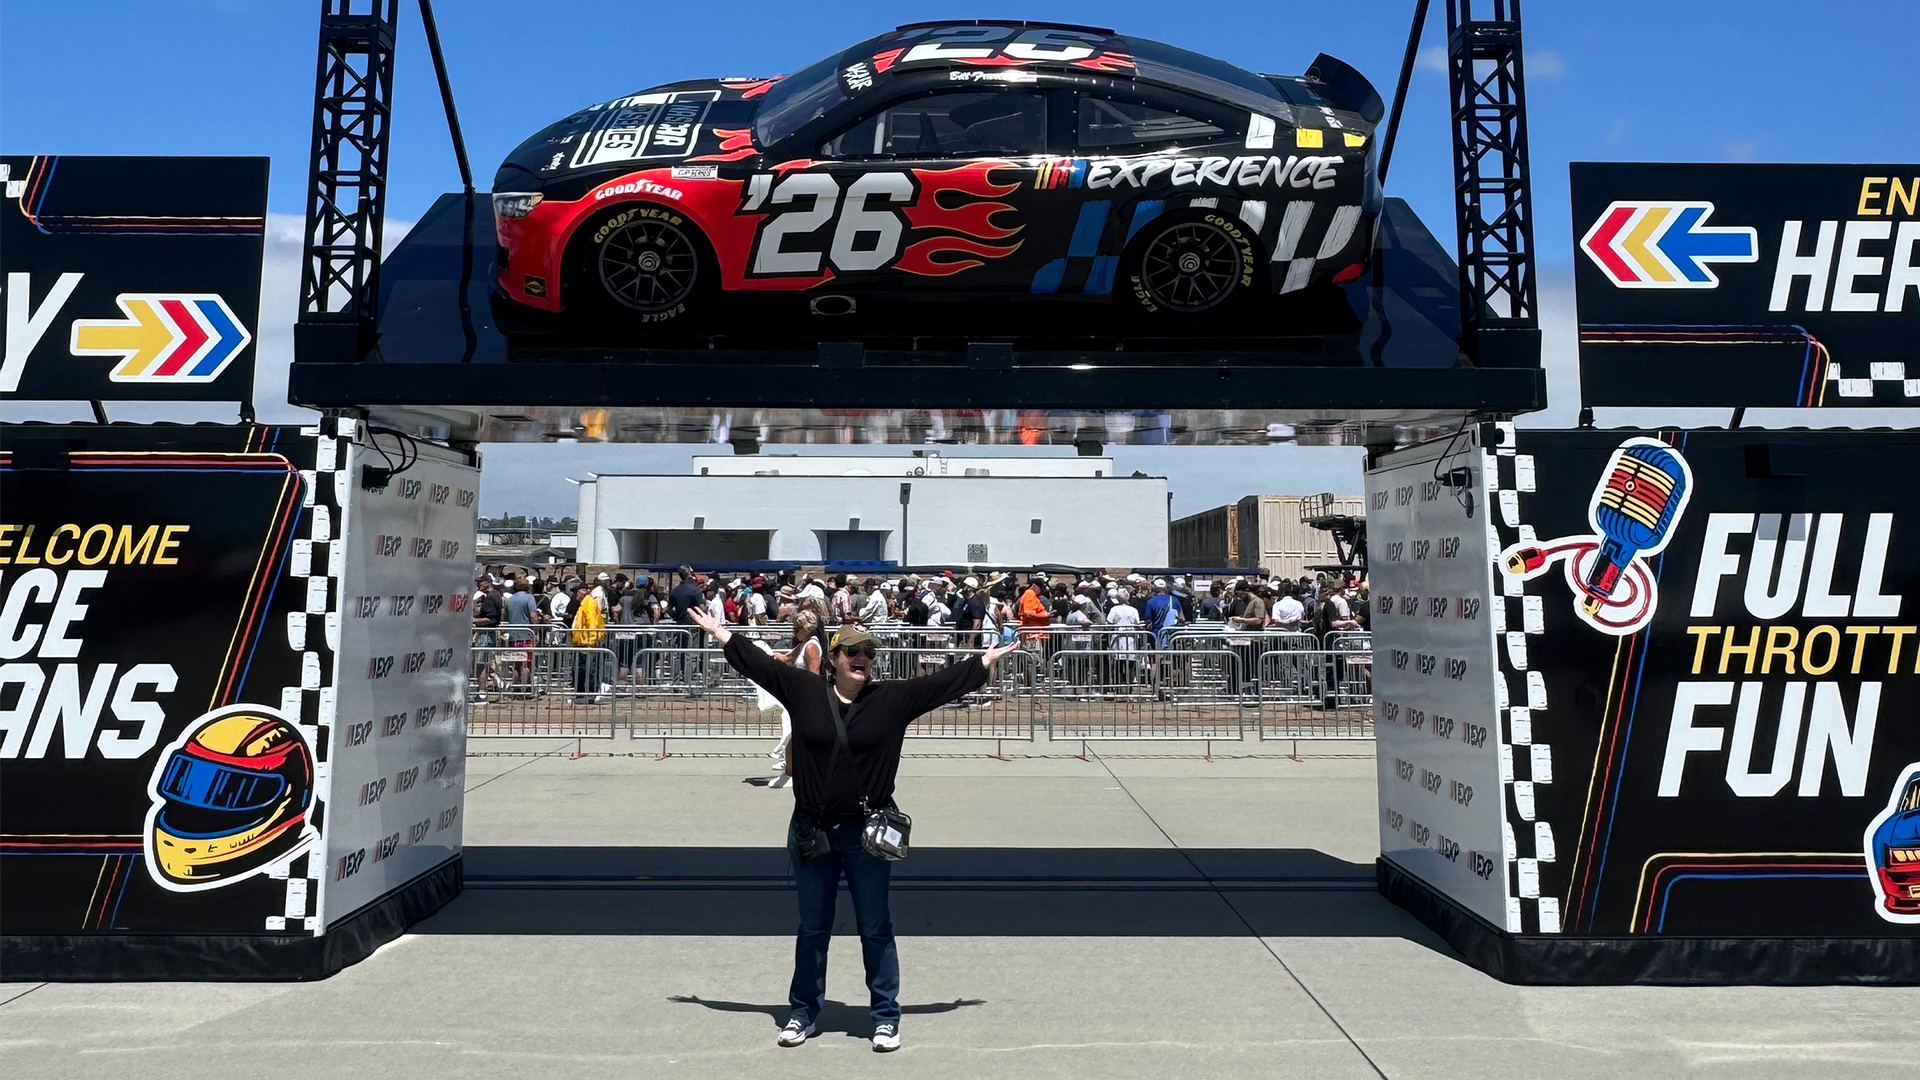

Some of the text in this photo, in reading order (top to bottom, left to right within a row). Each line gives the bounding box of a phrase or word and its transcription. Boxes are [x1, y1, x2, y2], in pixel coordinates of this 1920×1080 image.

[594, 179, 683, 200] GOODYEAR
[1086, 156, 1344, 189] EXPERIENCE
[594, 208, 682, 243] GOODYEAR
[1204, 214, 1254, 286] GOODYEAR
[641, 303, 685, 322] EAGLE
[1131, 275, 1158, 312] EAGLE
[1690, 512, 1902, 620] FULL
[0, 568, 108, 660] CE
[1686, 624, 1920, 676] THROTT
[1657, 681, 1883, 797] FUN
